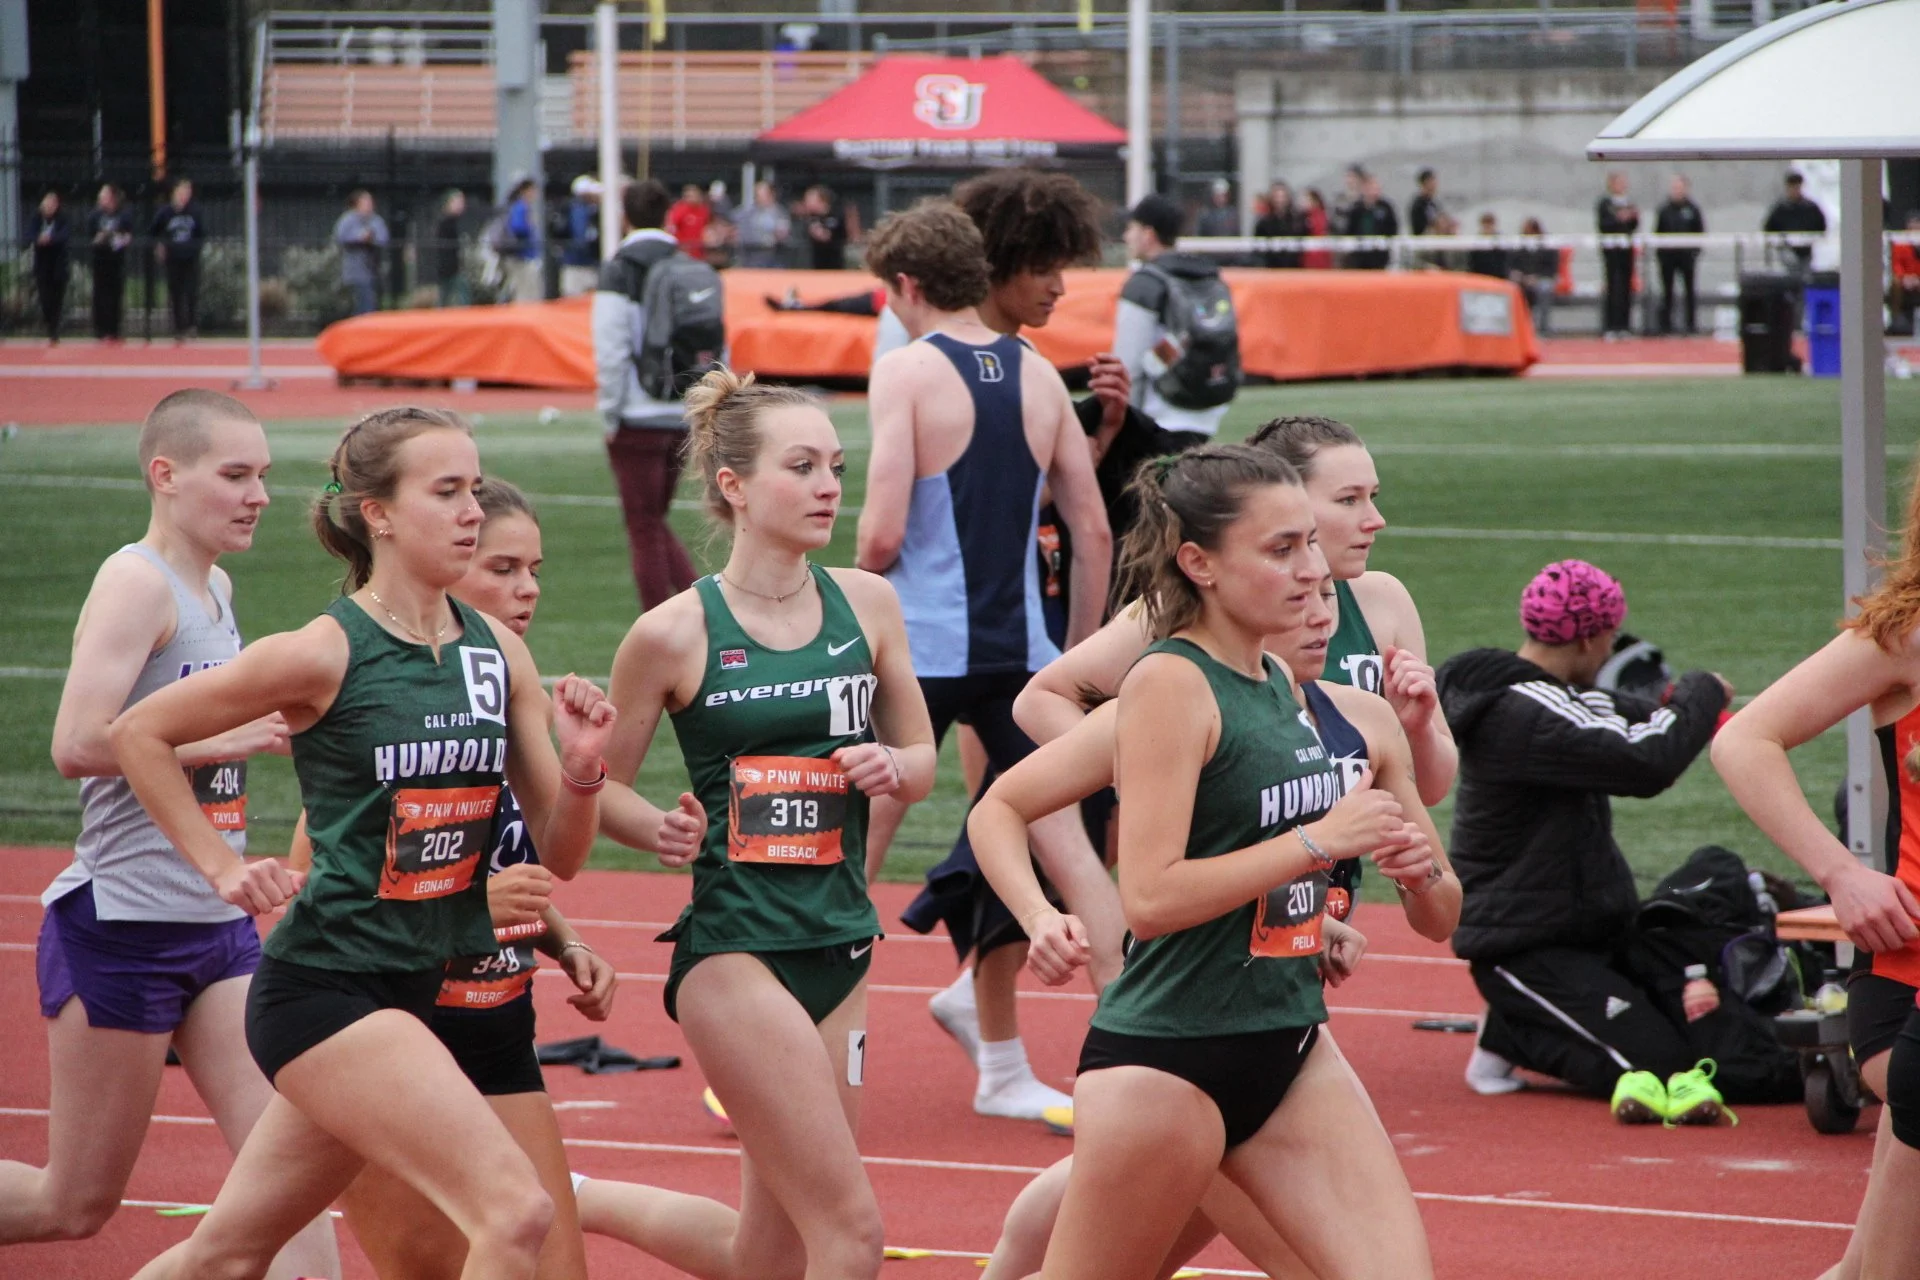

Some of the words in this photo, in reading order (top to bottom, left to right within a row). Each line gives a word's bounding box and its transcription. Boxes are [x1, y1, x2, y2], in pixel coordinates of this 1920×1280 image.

[469, 652, 501, 716] 5
[839, 679, 869, 731] 10
[424, 714, 447, 729] CAL
[374, 738, 507, 781] HUMBOLD
[1295, 747, 1310, 763] CAL
[1307, 745, 1323, 761] POLY
[210, 767, 239, 795] 404
[767, 769, 801, 785] PNW
[806, 771, 845, 789] INVITE
[213, 812, 240, 824] TAYLOR
[425, 803, 453, 818] PNW
[455, 799, 493, 816] INVITE
[770, 797, 819, 828] 313
[421, 830, 465, 862] 202
[767, 844, 819, 859] BIESACK
[413, 878, 456, 895] LEONARD
[1287, 880, 1315, 916] 207
[1292, 934, 1316, 950] PEILA
